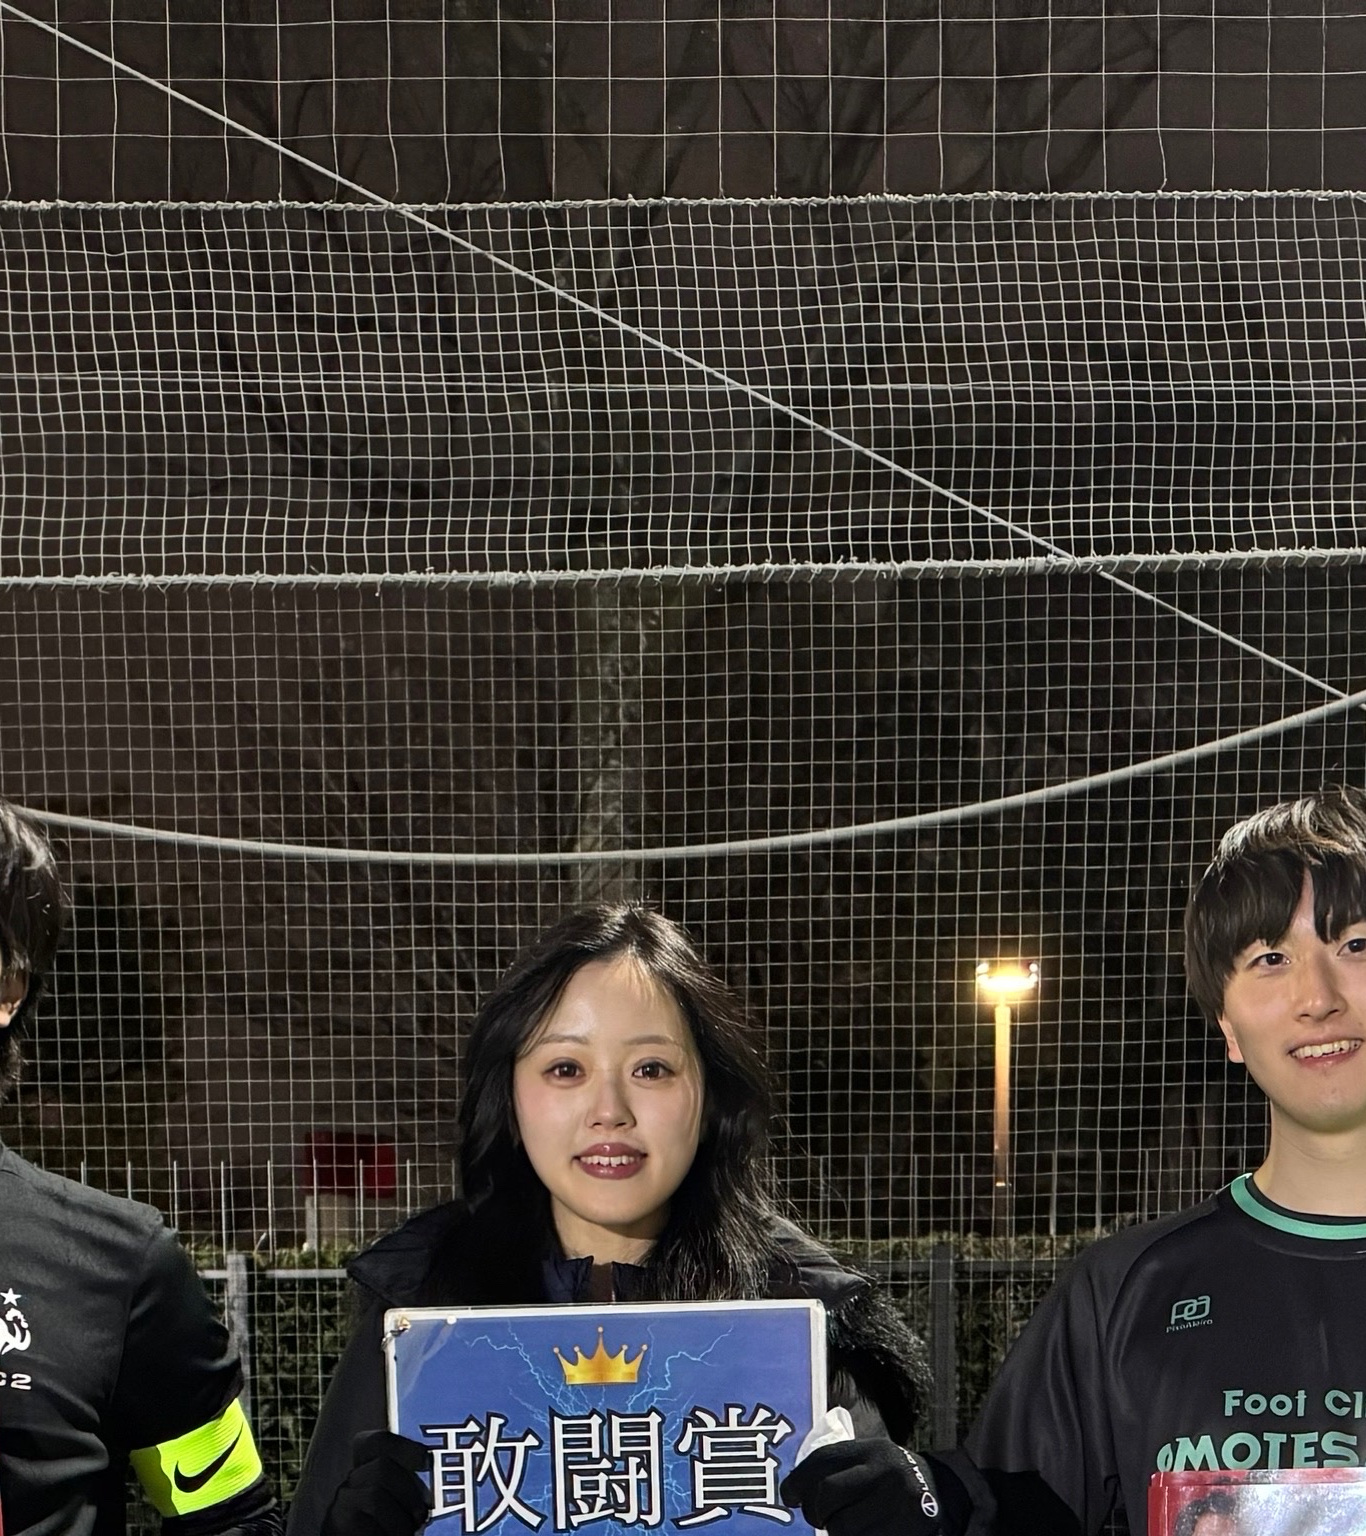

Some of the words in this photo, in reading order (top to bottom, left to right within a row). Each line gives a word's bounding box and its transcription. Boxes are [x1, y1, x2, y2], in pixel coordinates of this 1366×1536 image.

[1222, 1389, 1307, 1417] Foot
[422, 1404, 795, 1534] 敢闘賞
